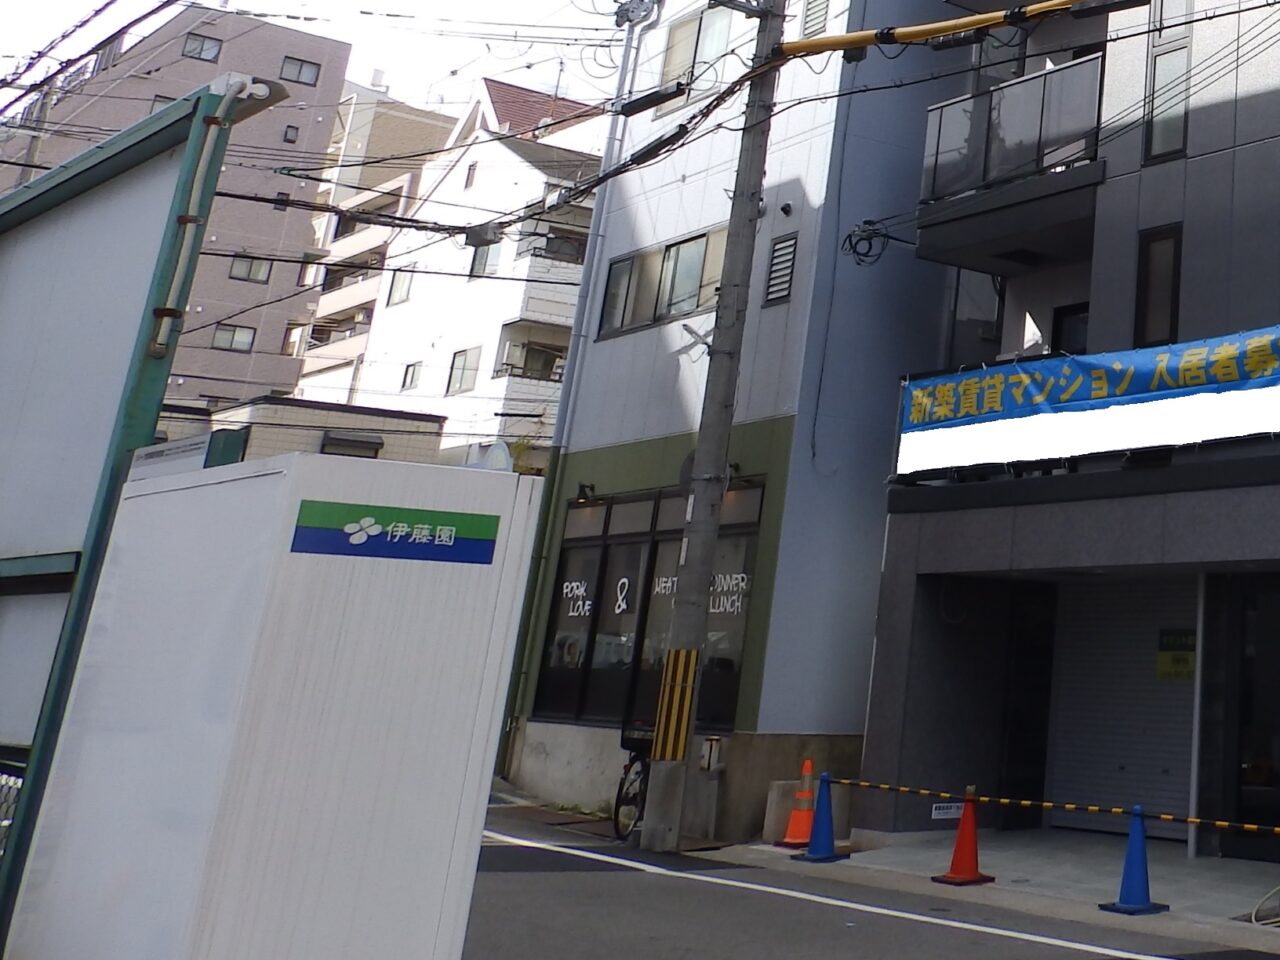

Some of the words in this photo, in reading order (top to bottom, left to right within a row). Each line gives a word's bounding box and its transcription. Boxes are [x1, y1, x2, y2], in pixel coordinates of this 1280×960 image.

[909, 360, 1135, 424] 新築賃貸マンション
[386, 521, 456, 546] 伊藤園
[563, 581, 587, 598] PORK
[615, 577, 629, 614] &
[568, 600, 592, 617] LOVE
